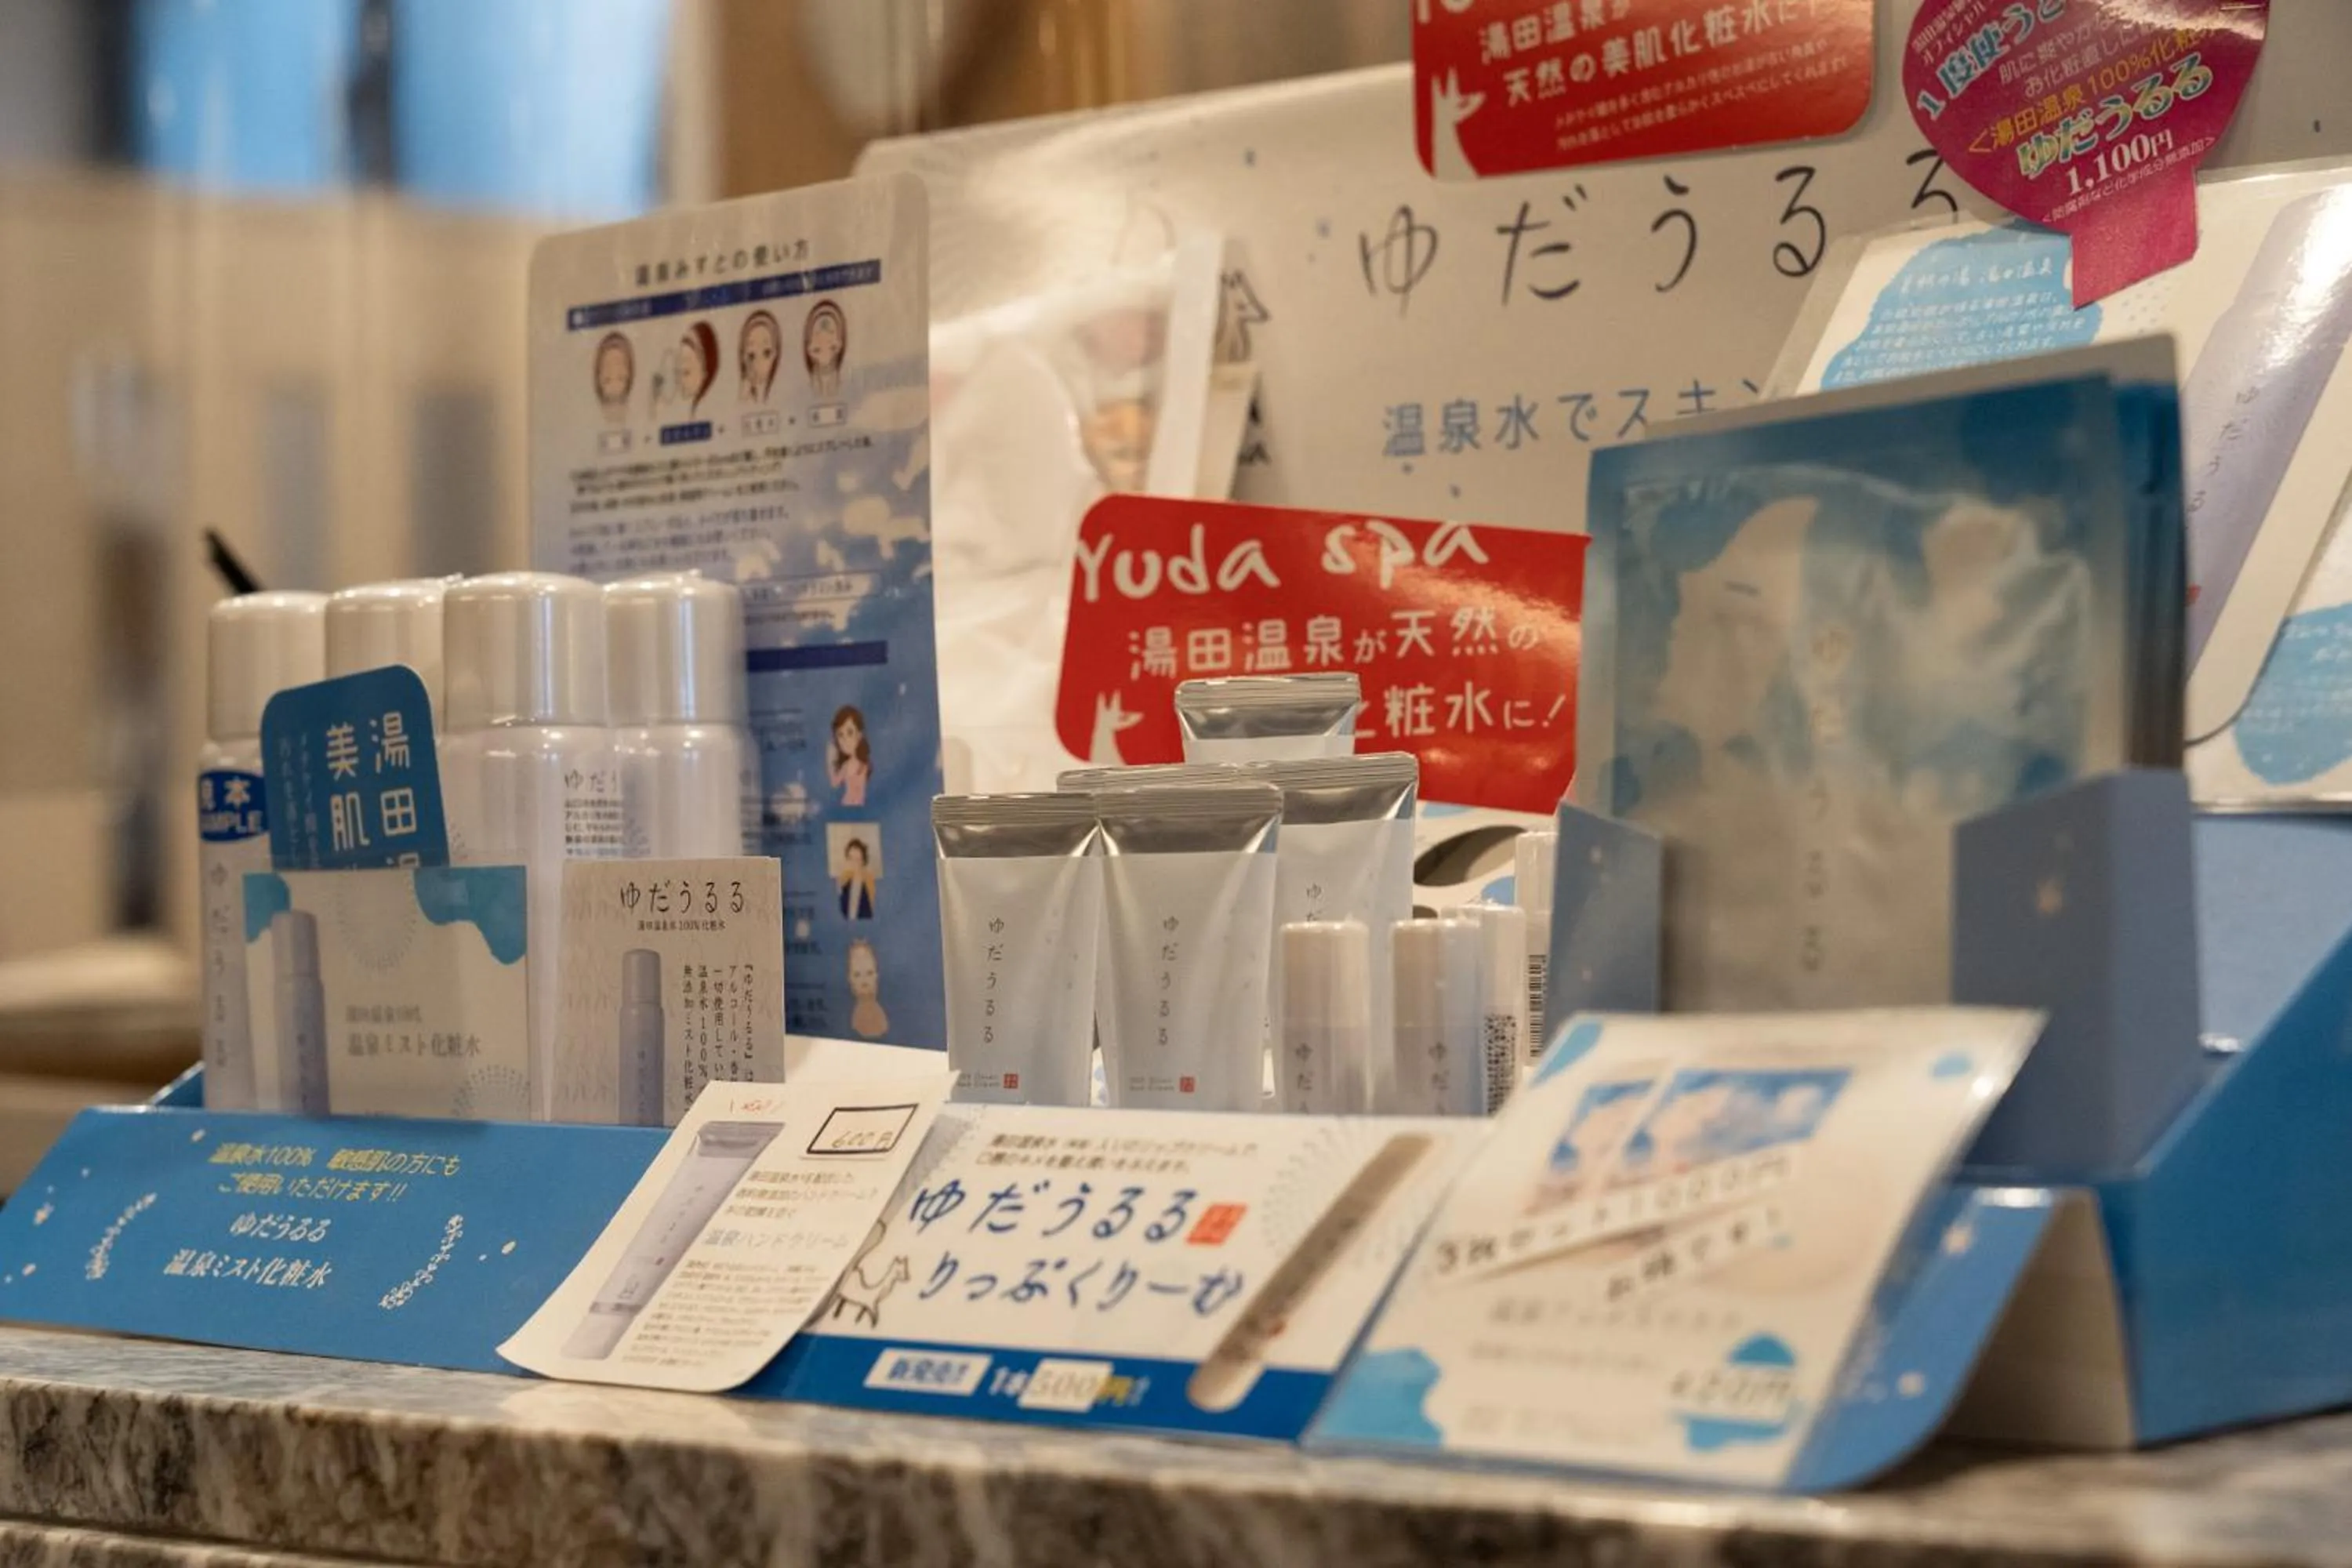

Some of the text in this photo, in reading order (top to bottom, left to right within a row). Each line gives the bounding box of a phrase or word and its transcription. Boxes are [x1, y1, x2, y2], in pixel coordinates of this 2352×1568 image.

[2016, 51, 2213, 180] ゆだうるる
[2065, 129, 2175, 196] 1,100円
[2184, 387, 2260, 530] ゆだうる
[1321, 520, 1489, 590] spa
[1127, 606, 1540, 681] 湯田温泉が天然の
[326, 721, 370, 852] 美肌
[619, 880, 744, 914] ゆだうるる
[697, 964, 710, 1094] 温泉水100%
[982, 916, 1004, 1045] ゆだうるる
[1157, 916, 1181, 1046] ゆだうるる
[682, 964, 695, 1113] 無添加ミスト化粧水
[229, 1210, 332, 1243] ゆだうるる
[909, 1178, 1198, 1243] ゆだうるる
[163, 1247, 333, 1289] 温泉ミスト化粧水
